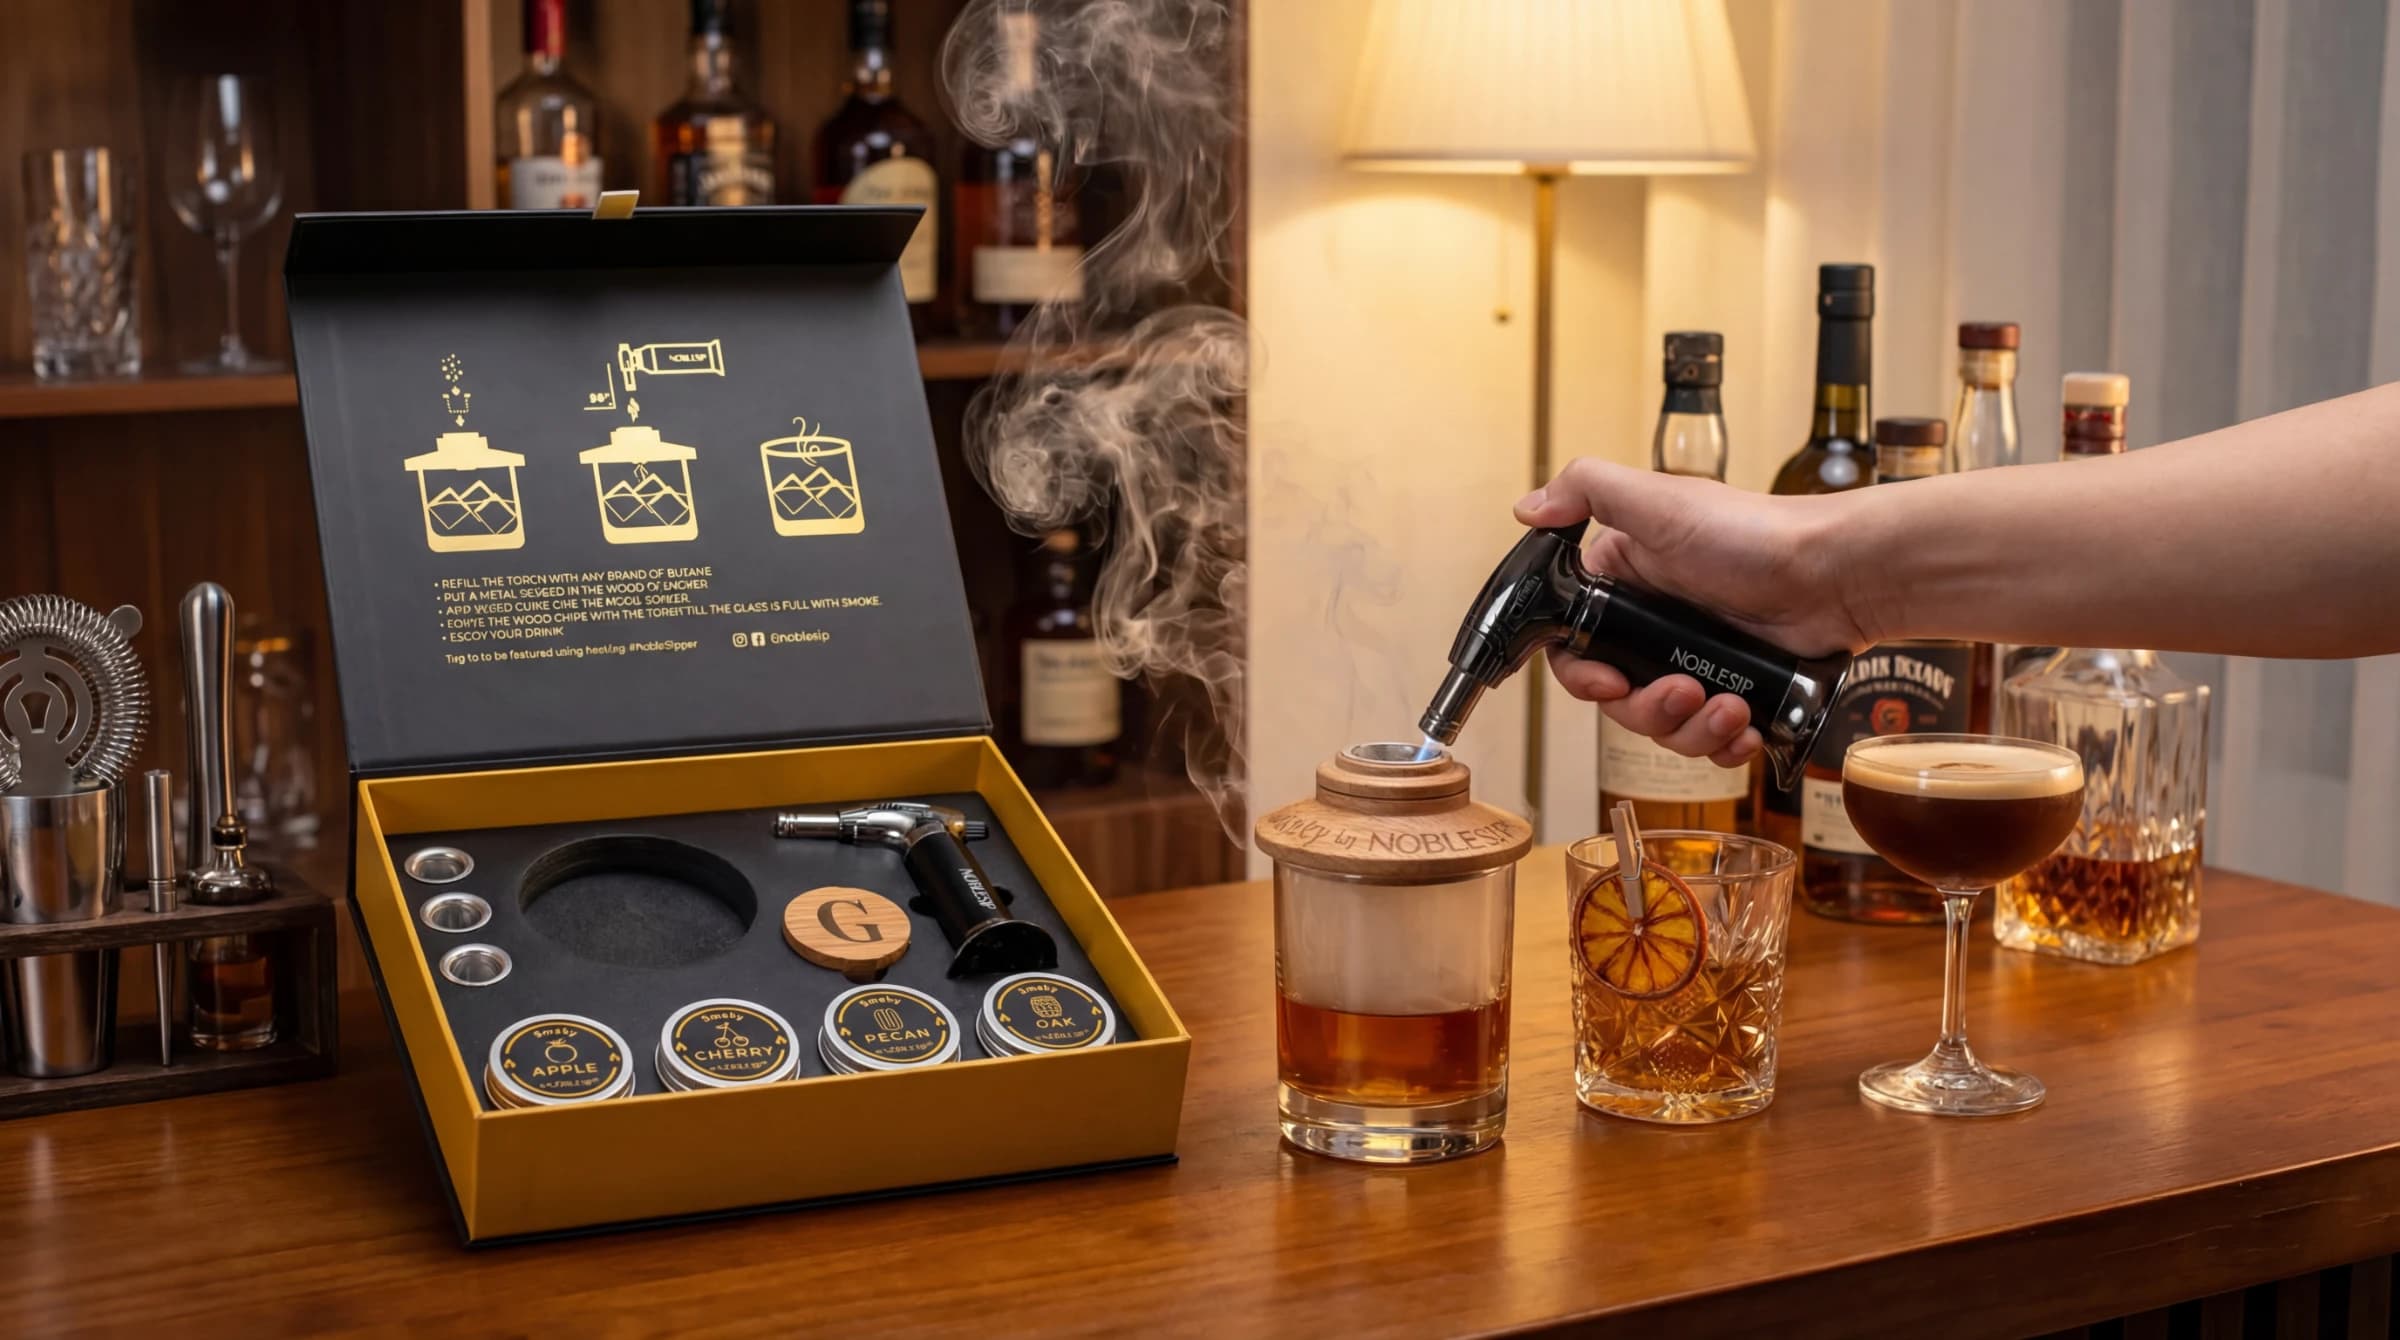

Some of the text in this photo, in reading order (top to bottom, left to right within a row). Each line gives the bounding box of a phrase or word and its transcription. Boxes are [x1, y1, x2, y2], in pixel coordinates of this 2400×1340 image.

[442, 578, 480, 590] REFILL
[481, 576, 504, 587] THE
[548, 572, 579, 584] WITH
[581, 571, 605, 582] ANY
[607, 569, 647, 581] BRAND
[648, 568, 664, 580] OF
[444, 591, 466, 603] PUT
[468, 591, 478, 601] A
[480, 589, 518, 600] METAL
[568, 585, 579, 596] IN
[581, 584, 604, 595] THE
[606, 582, 645, 593] WOOD
[581, 597, 604, 608] THE
[488, 615, 511, 627] THE
[512, 613, 552, 625] WOOD
[590, 610, 620, 621] WITH
[621, 608, 645, 619] THE
[709, 603, 731, 615] THE
[770, 601, 781, 611] IS
[782, 599, 809, 610] FULL
[810, 597, 840, 609] WITH
[489, 628, 522, 640] YOUR
[467, 653, 479, 662] to
[480, 652, 492, 662] to
[494, 651, 508, 661] be
[1669, 646, 1755, 695] NOBLESIP
[816, 899, 883, 943] G
[1035, 1016, 1077, 1029] OAK
[864, 1027, 931, 1044] PECAN
[694, 1045, 773, 1061] CHERRY
[532, 1062, 599, 1078] APPLE
